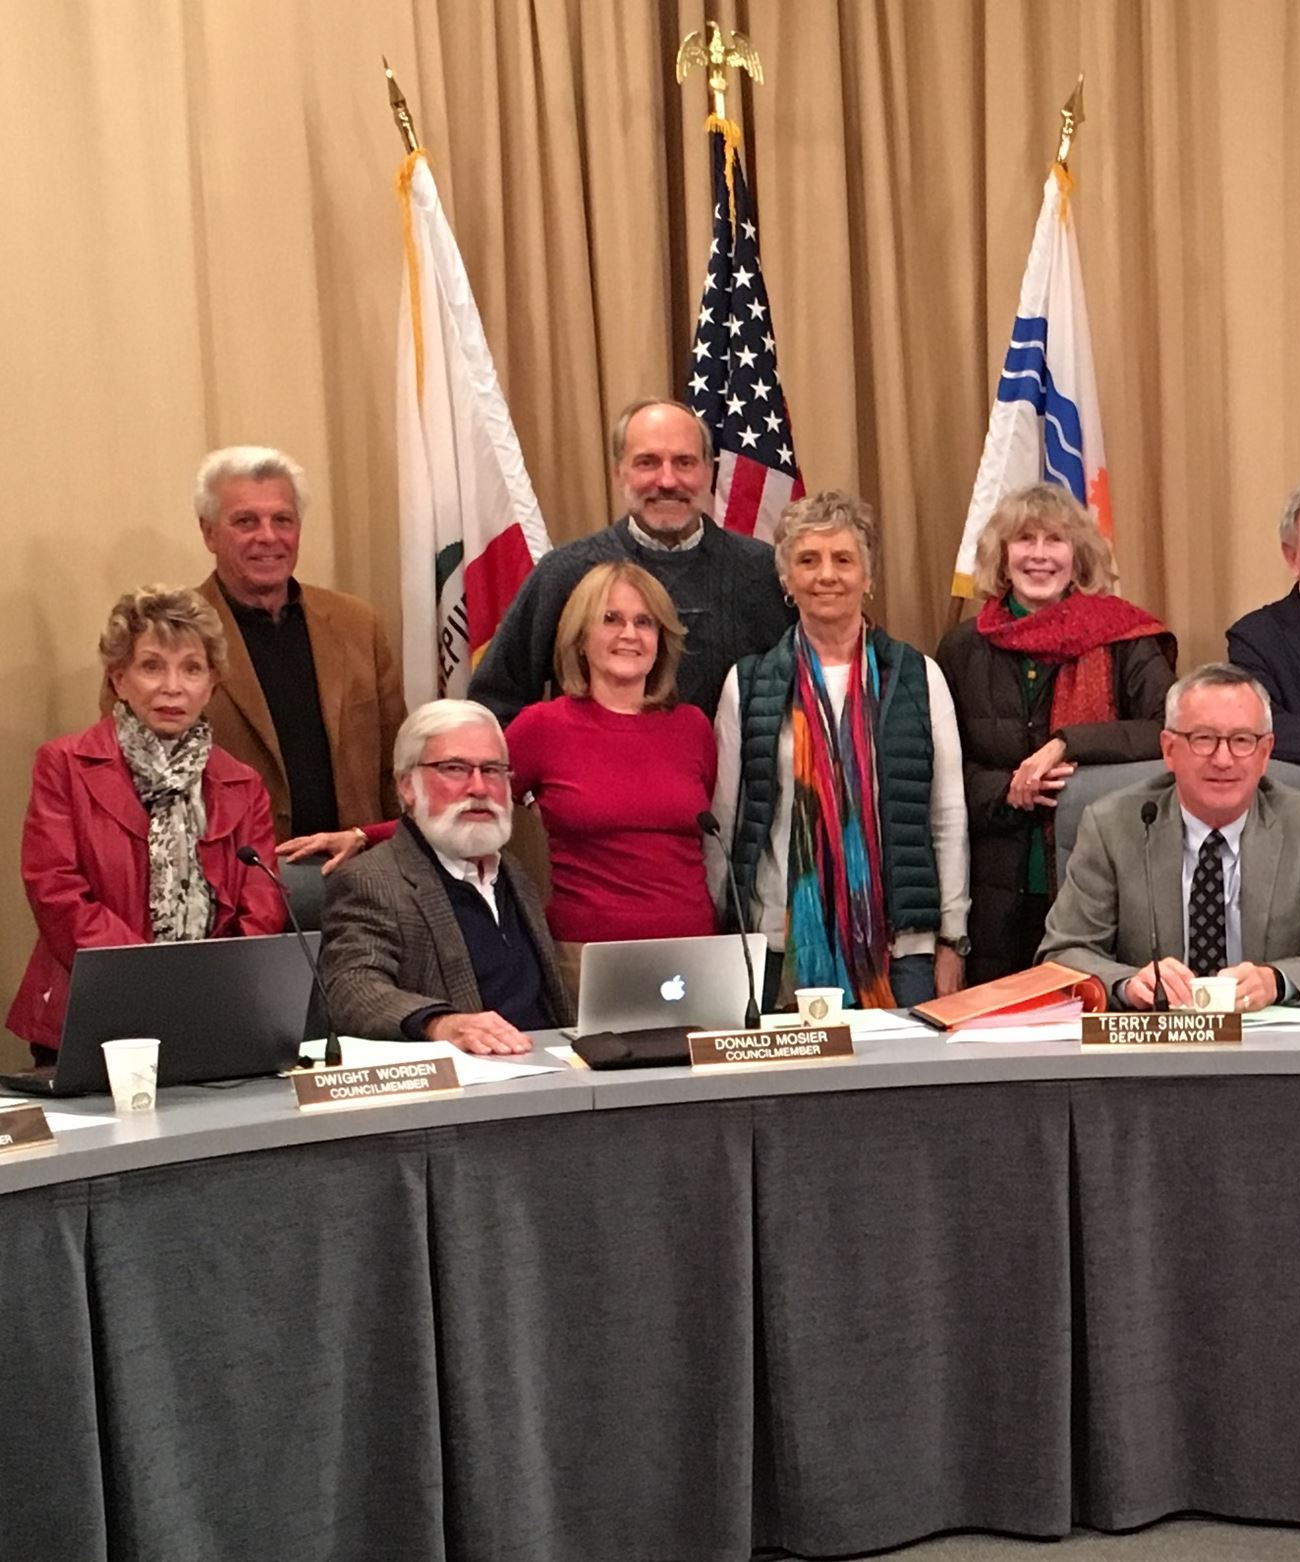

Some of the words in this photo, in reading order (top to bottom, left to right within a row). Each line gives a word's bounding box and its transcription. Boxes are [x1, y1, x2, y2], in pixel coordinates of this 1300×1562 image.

[1099, 1016, 1150, 1031] TERRY
[1158, 1014, 1225, 1030] SINNOTT
[714, 1037, 771, 1050] DONALD
[776, 1031, 828, 1046] MOSIER
[1109, 1031, 1162, 1043] DEPUTY
[1168, 1030, 1215, 1042] MAYOR
[725, 1045, 821, 1062] COUNCILMEMBER
[314, 1070, 370, 1088] DWIGHT
[376, 1063, 437, 1081] WORDEN
[330, 1078, 429, 1099] COUNCILMEMBER
